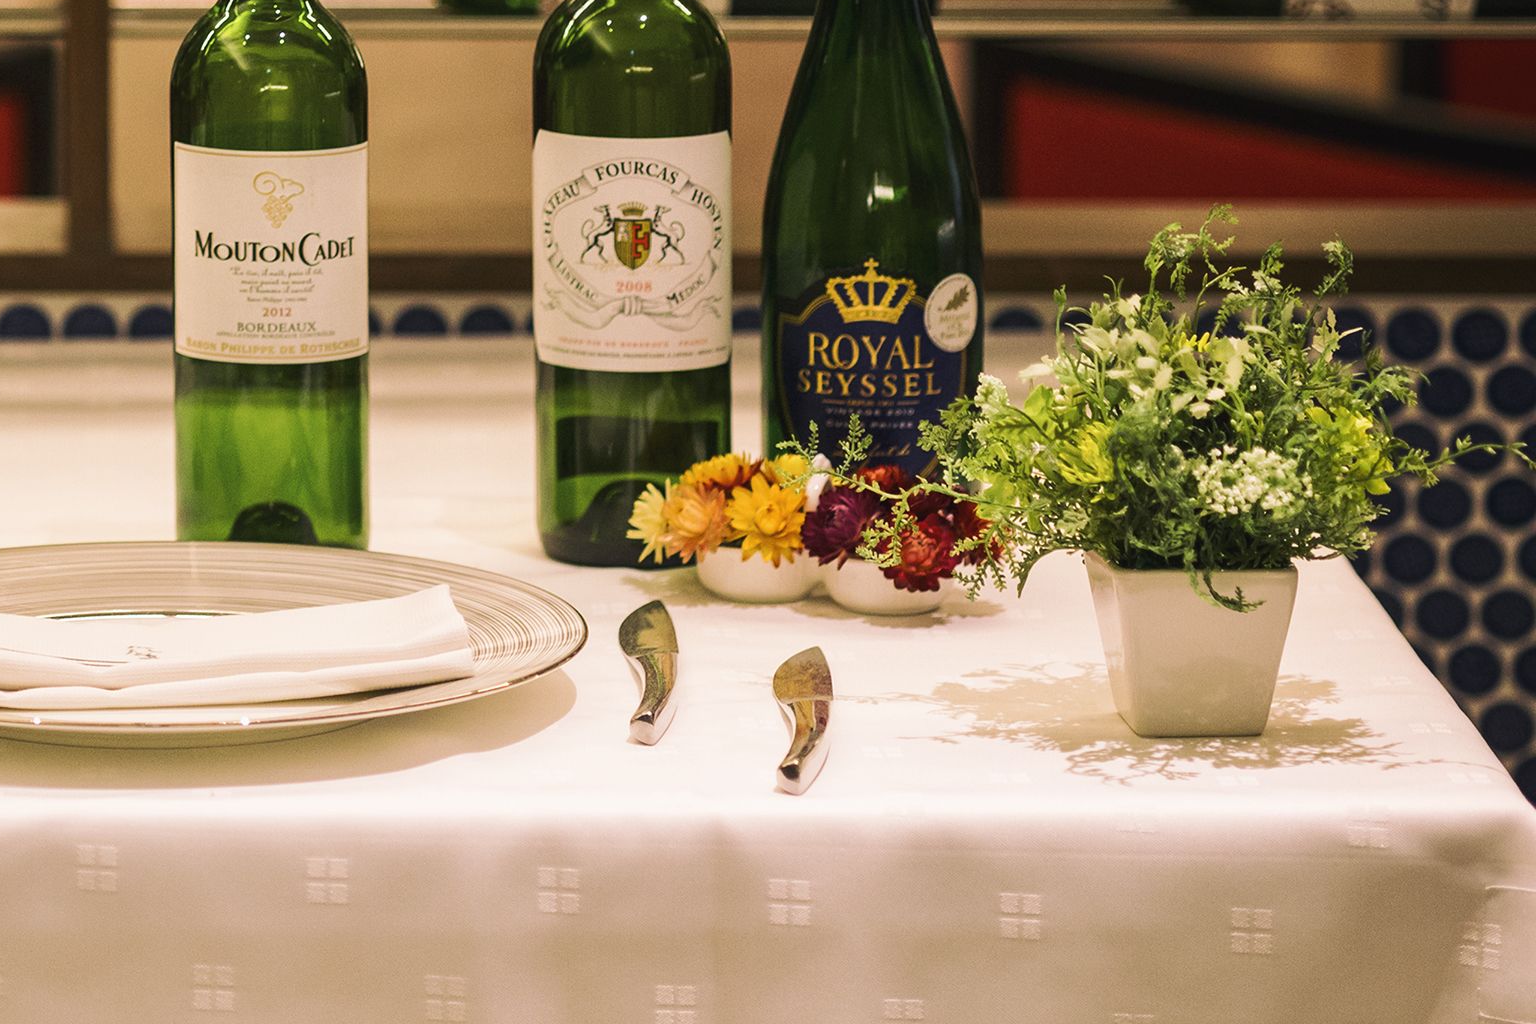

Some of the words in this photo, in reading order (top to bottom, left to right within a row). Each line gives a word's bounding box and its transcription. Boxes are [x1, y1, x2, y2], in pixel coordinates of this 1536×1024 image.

[595, 160, 679, 185] FOURCAS
[195, 230, 295, 263] MOUTON
[298, 232, 355, 266] CADET
[262, 307, 292, 317] 2012
[237, 322, 318, 333] BORDEAUX
[221, 342, 275, 354] PHILIPPE
[279, 345, 296, 354] DE
[808, 332, 935, 370] ROYAL
[797, 369, 942, 398] SEYSSEL
